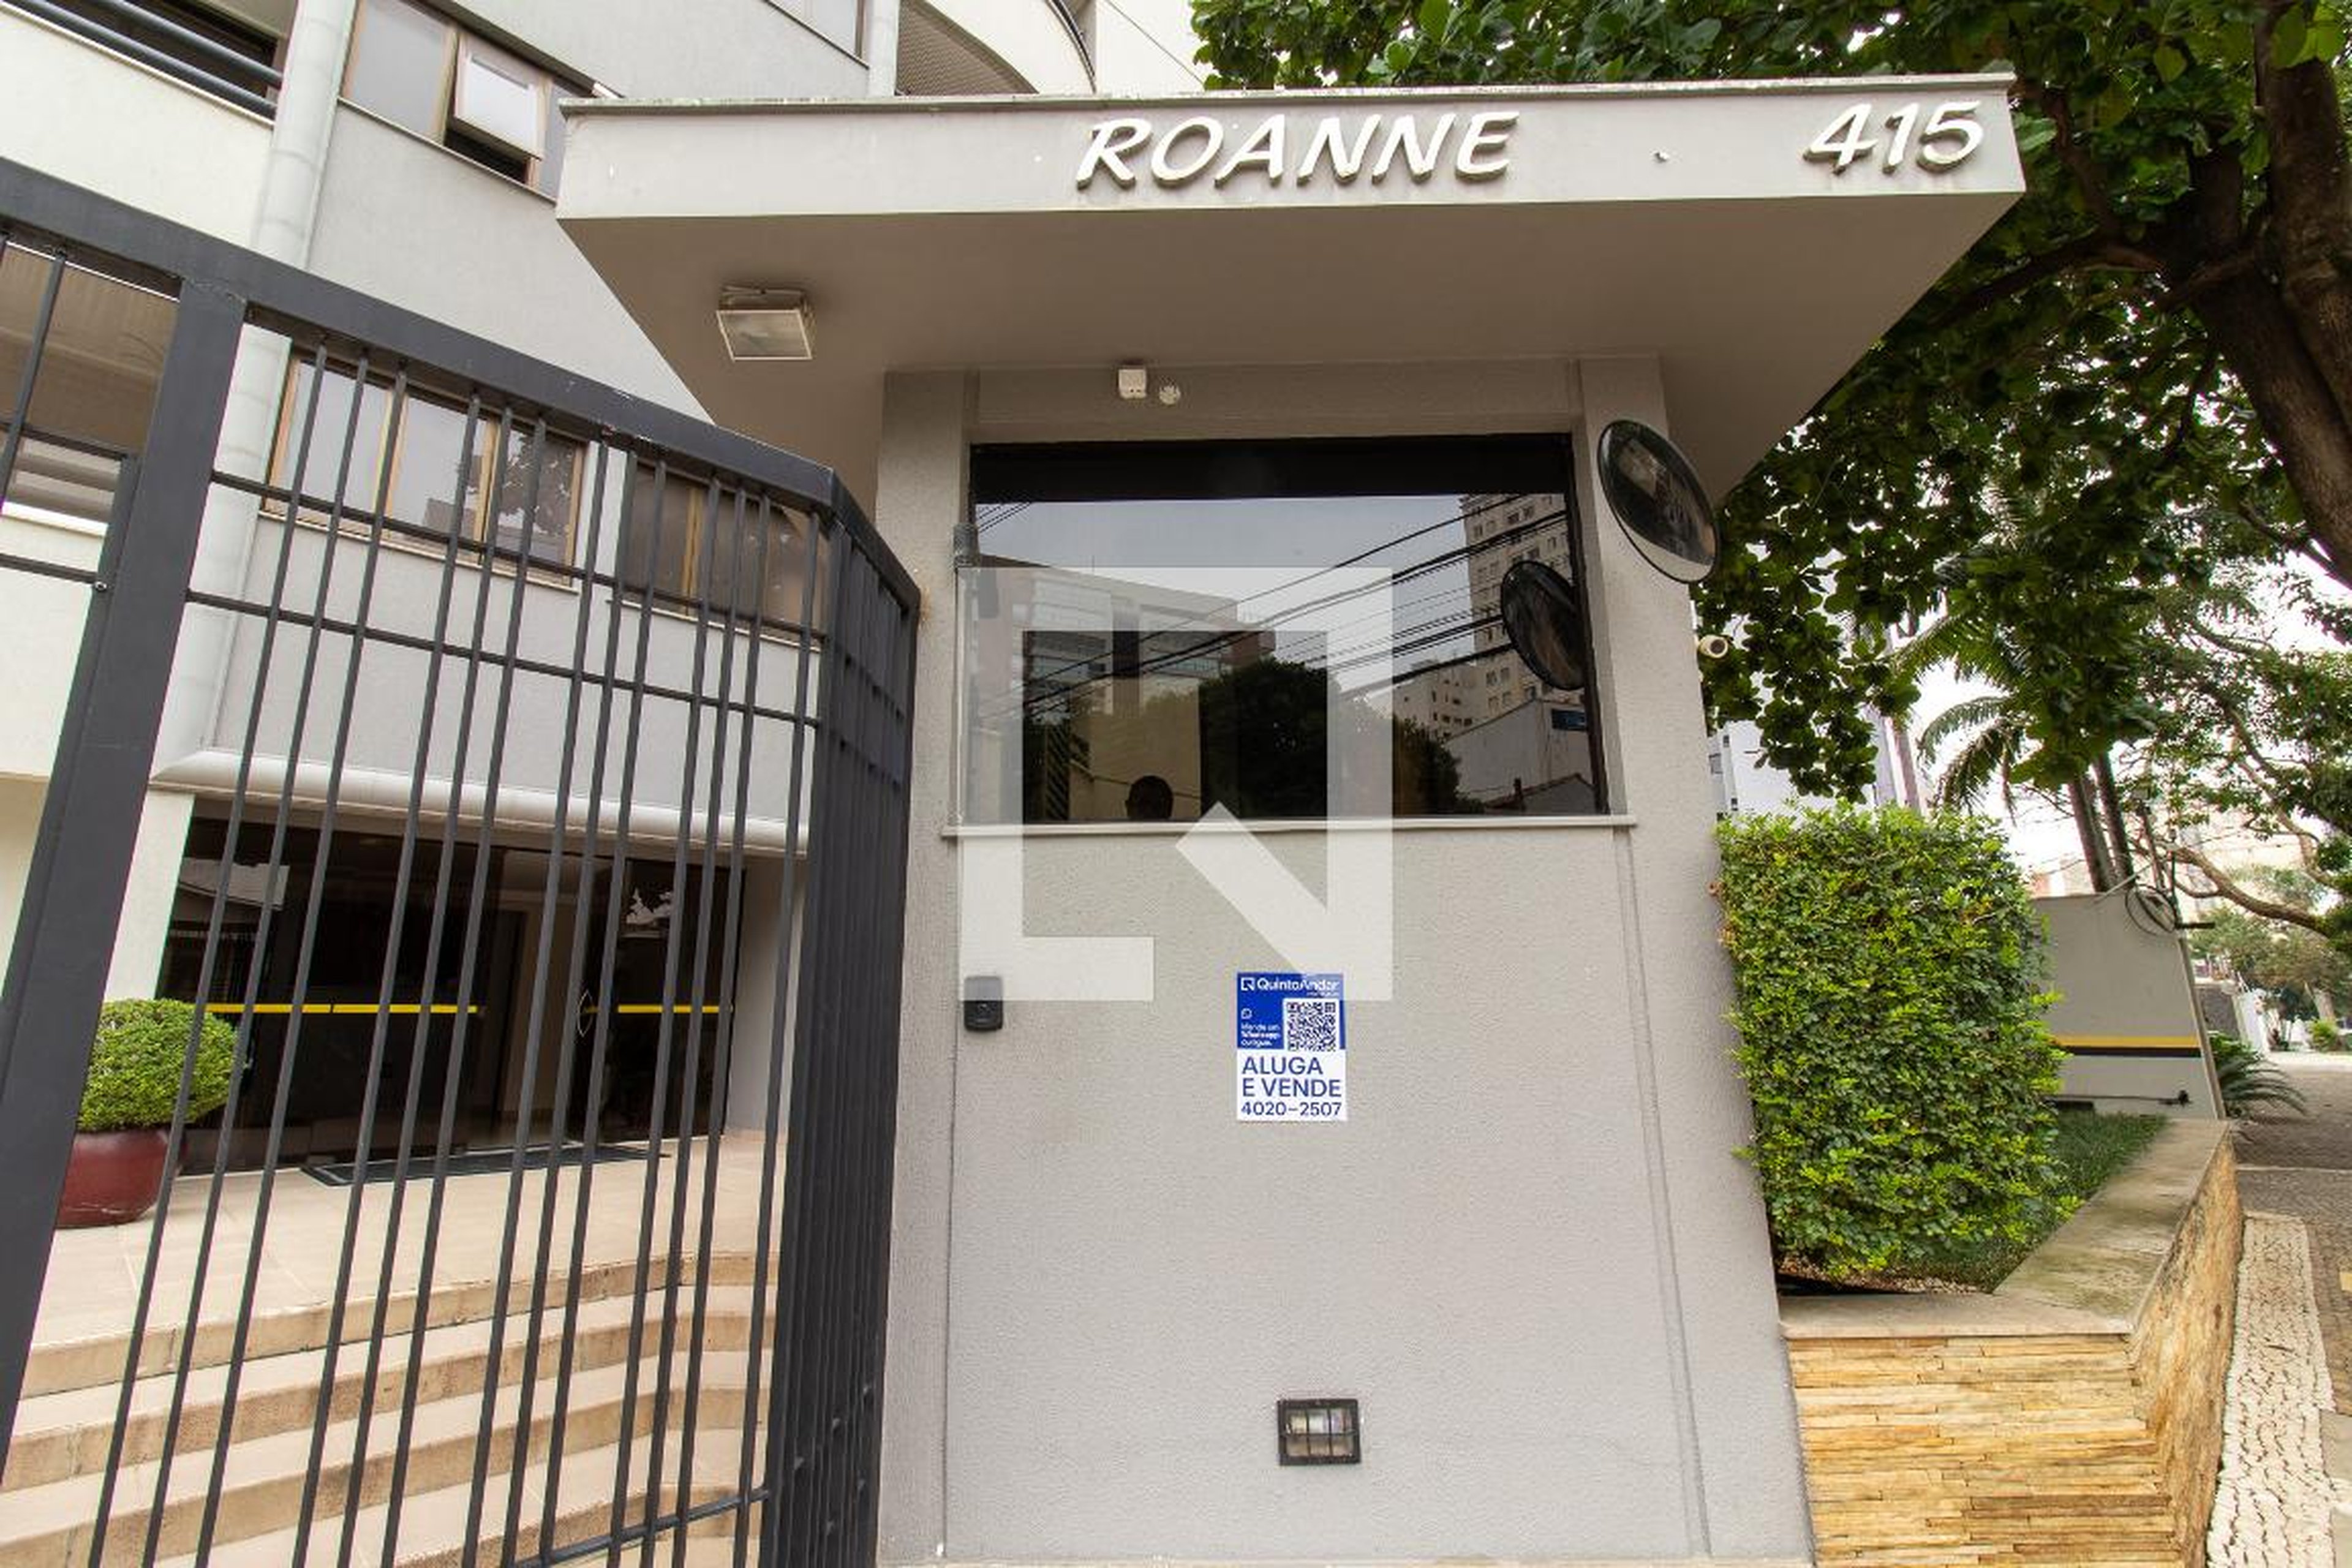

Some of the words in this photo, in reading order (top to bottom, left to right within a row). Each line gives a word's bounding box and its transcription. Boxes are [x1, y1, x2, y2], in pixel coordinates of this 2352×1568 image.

[1803, 100, 1984, 175] 415
[1076, 111, 1519, 189] ROANNE
[1257, 977, 1340, 991] QuintoAndar
[1242, 1057, 1323, 1075] ALUGA
[1243, 1078, 1254, 1097] E
[1261, 1078, 1341, 1097] VENDE
[1241, 1102, 1341, 1116] 4020-2507
